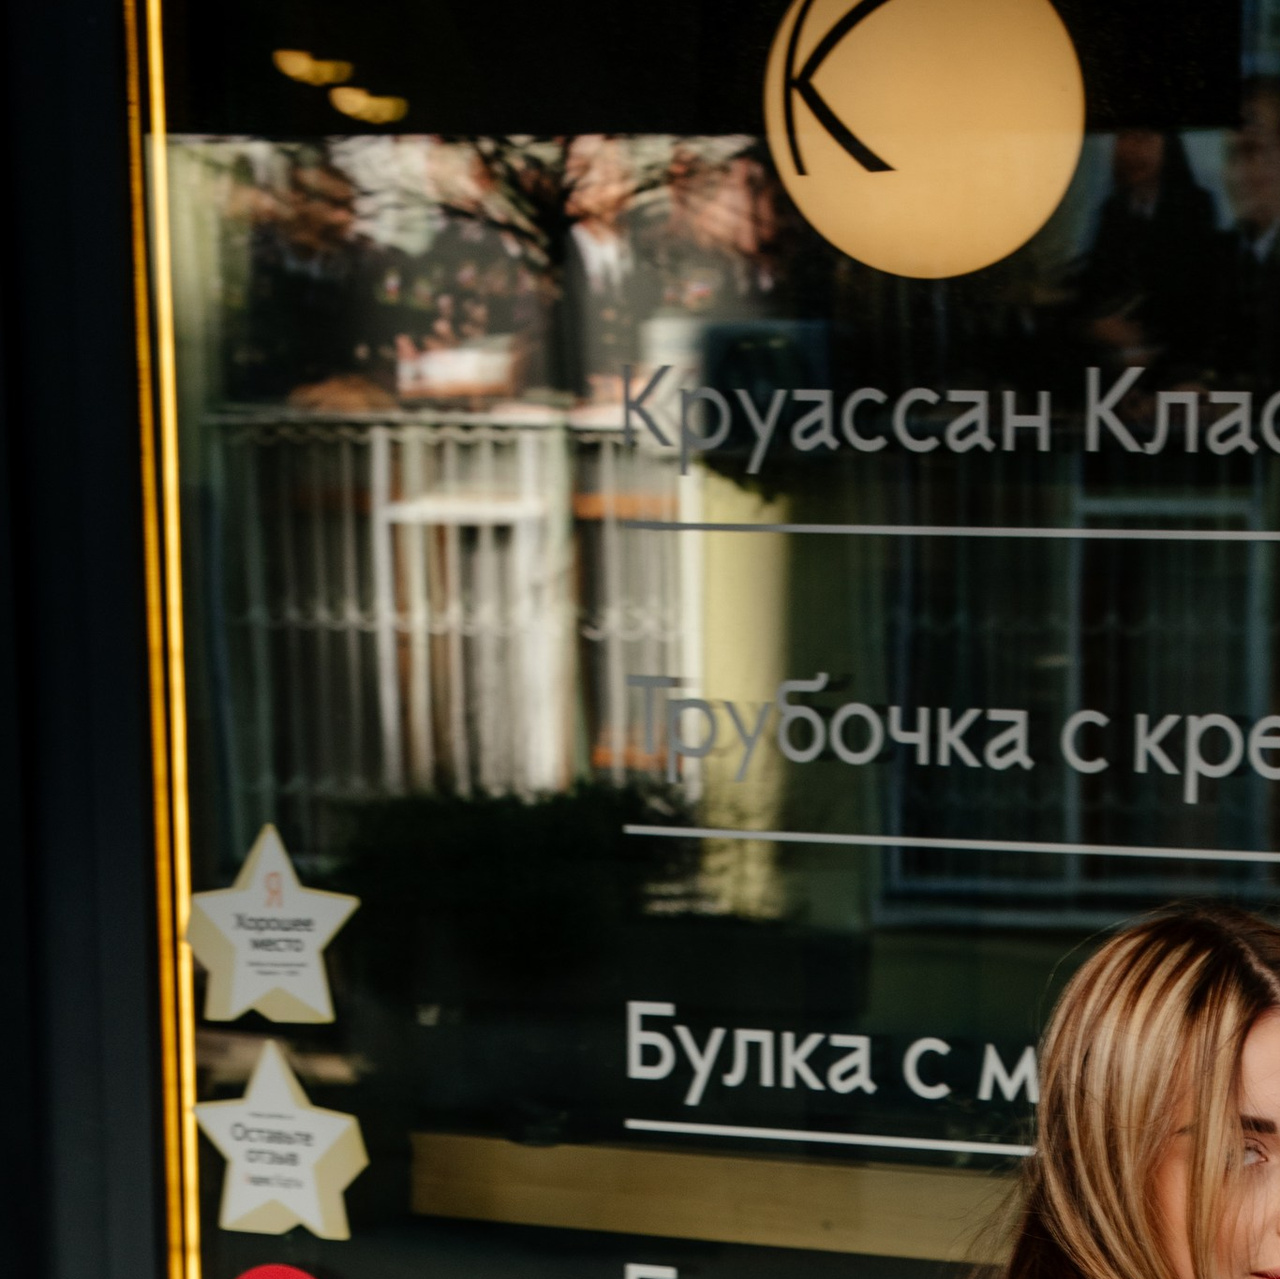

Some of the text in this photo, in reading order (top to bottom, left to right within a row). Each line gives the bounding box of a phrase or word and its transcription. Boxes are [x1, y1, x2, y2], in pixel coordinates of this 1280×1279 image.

[622, 363, 1051, 476] Круассан
[626, 672, 1034, 785] Трубочка
[1060, 709, 1110, 774] с
[626, 1001, 878, 1106] Булка
[903, 1037, 952, 1100] с
